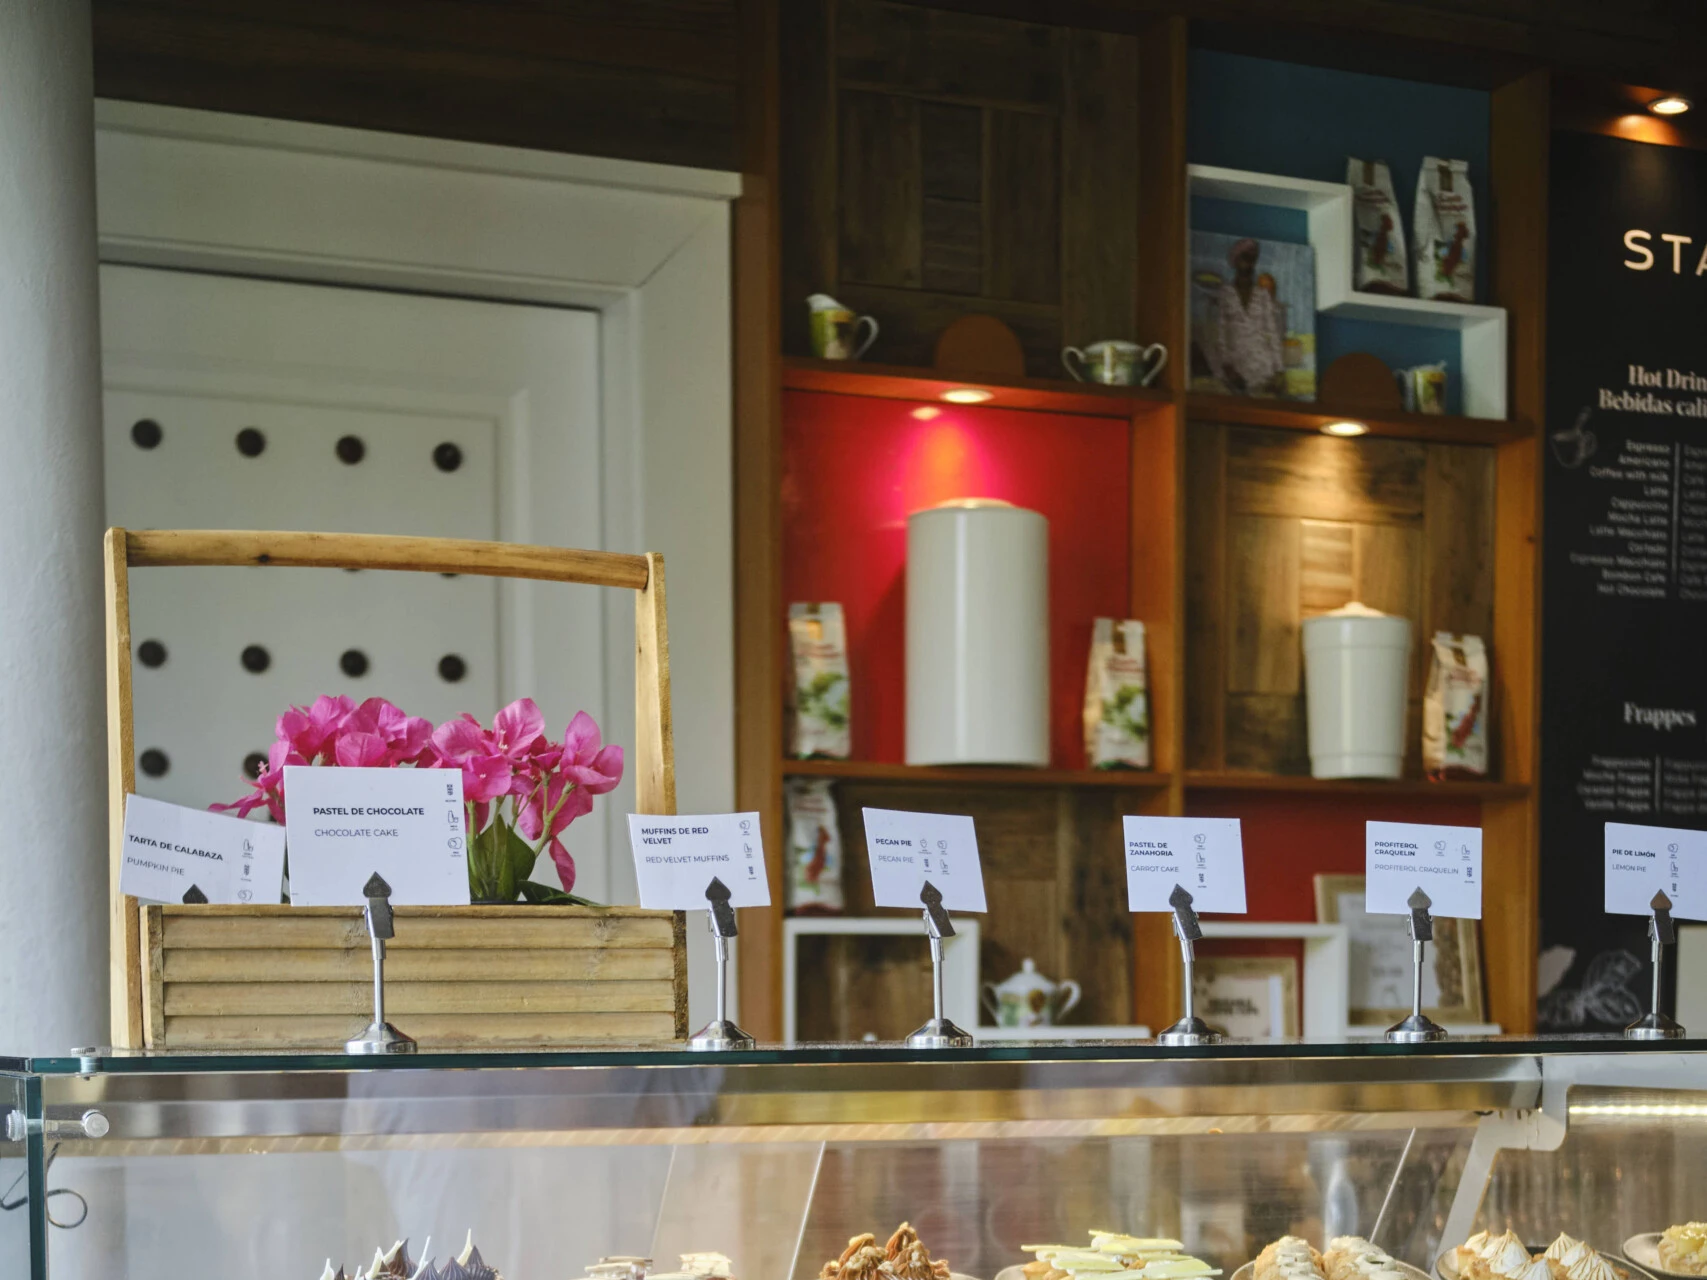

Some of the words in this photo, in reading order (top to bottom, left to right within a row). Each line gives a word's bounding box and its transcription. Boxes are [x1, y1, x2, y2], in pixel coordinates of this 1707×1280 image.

[1628, 364, 1662, 388] Hot
[1599, 388, 1673, 414] Bebidas
[1624, 702, 1696, 731] Frappes
[313, 807, 349, 816] PASTEL
[351, 807, 364, 816] DE
[367, 806, 425, 816] CHOCOLATE
[314, 828, 373, 838] CHOCOLATE
[375, 828, 399, 838] CAKE
[641, 827, 677, 836] MUFFINS
[679, 827, 690, 836] DE
[692, 826, 709, 835] RED
[643, 837, 672, 846] VELVET
[875, 838, 898, 847] PECAN
[900, 839, 912, 848] PIE
[1129, 841, 1155, 849] PASTEL
[1374, 841, 1419, 850] PROFITEROL
[129, 834, 158, 848] TARTA
[160, 841, 173, 852] DE
[174, 844, 223, 862] CALABAZA
[1129, 849, 1174, 857] ZANAHORIA
[1374, 848, 1416, 857] CRAQUELIN
[645, 856, 662, 865] RED
[663, 855, 691, 864] VELVET
[693, 853, 730, 863] MUFFINS
[878, 854, 901, 863] PECAN
[902, 855, 914, 864] PIE
[127, 856, 168, 873] PUMPKIN
[170, 866, 185, 877] PIE
[1130, 864, 1159, 873] CARROT
[1374, 863, 1417, 873] PROFITEROL
[1418, 866, 1459, 875] CRAQUELIN
[1636, 865, 1647, 873] PIE
